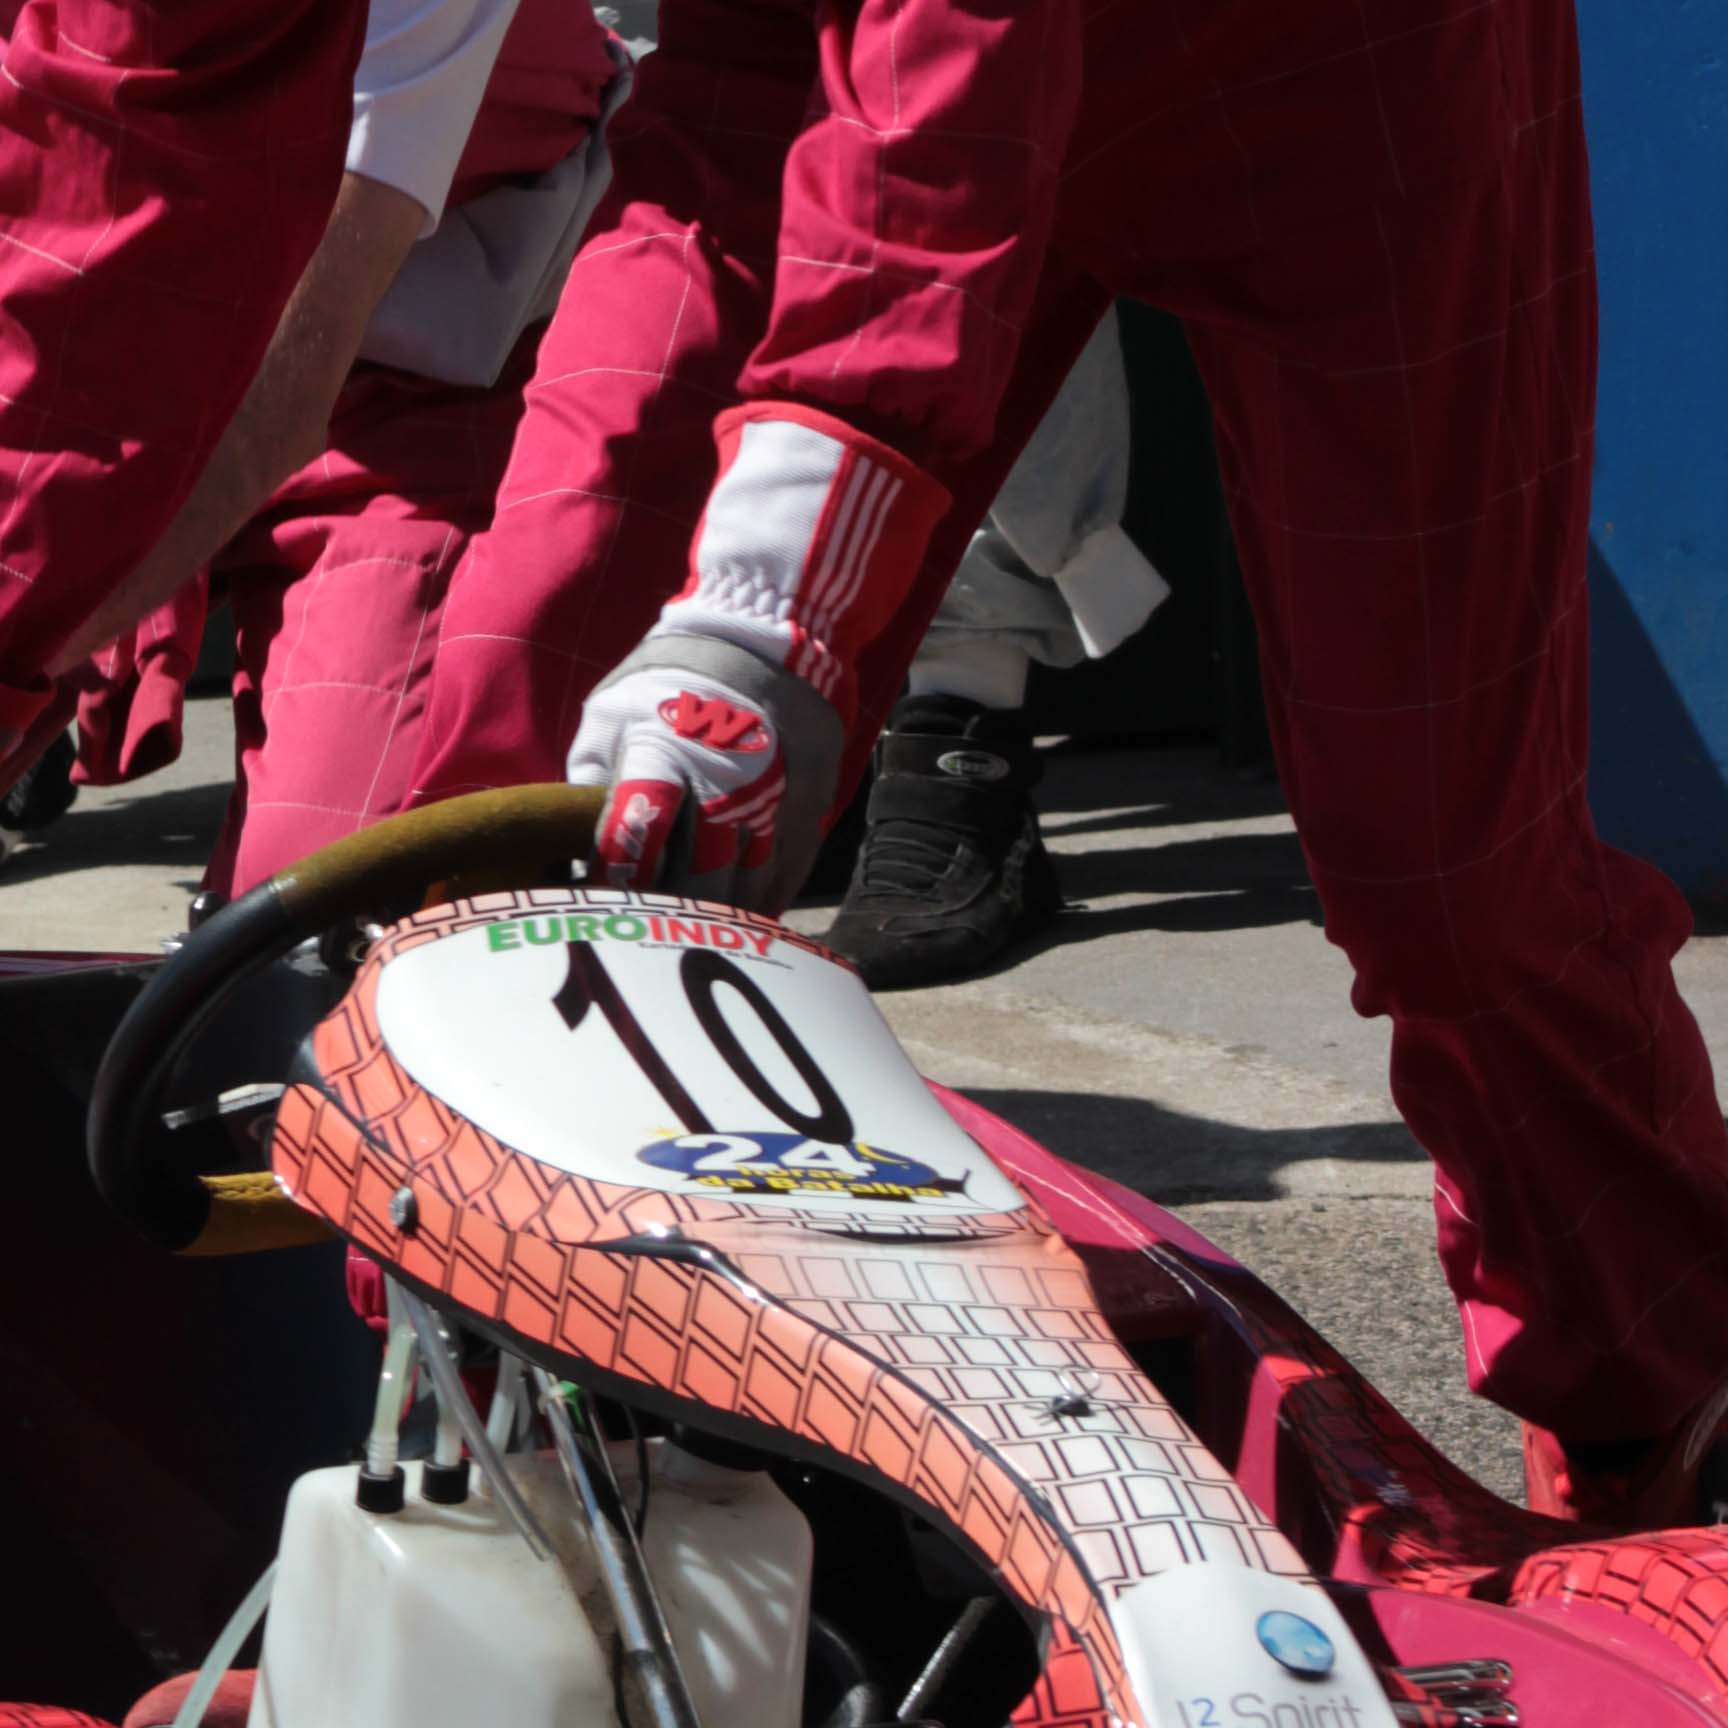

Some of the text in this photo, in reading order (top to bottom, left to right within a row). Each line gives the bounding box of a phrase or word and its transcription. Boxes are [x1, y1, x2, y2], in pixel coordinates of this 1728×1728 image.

[486, 913, 774, 956] EUROINDY
[551, 939, 855, 1145] 10
[674, 1134, 878, 1177] 24
[764, 1174, 946, 1198] Batalha
